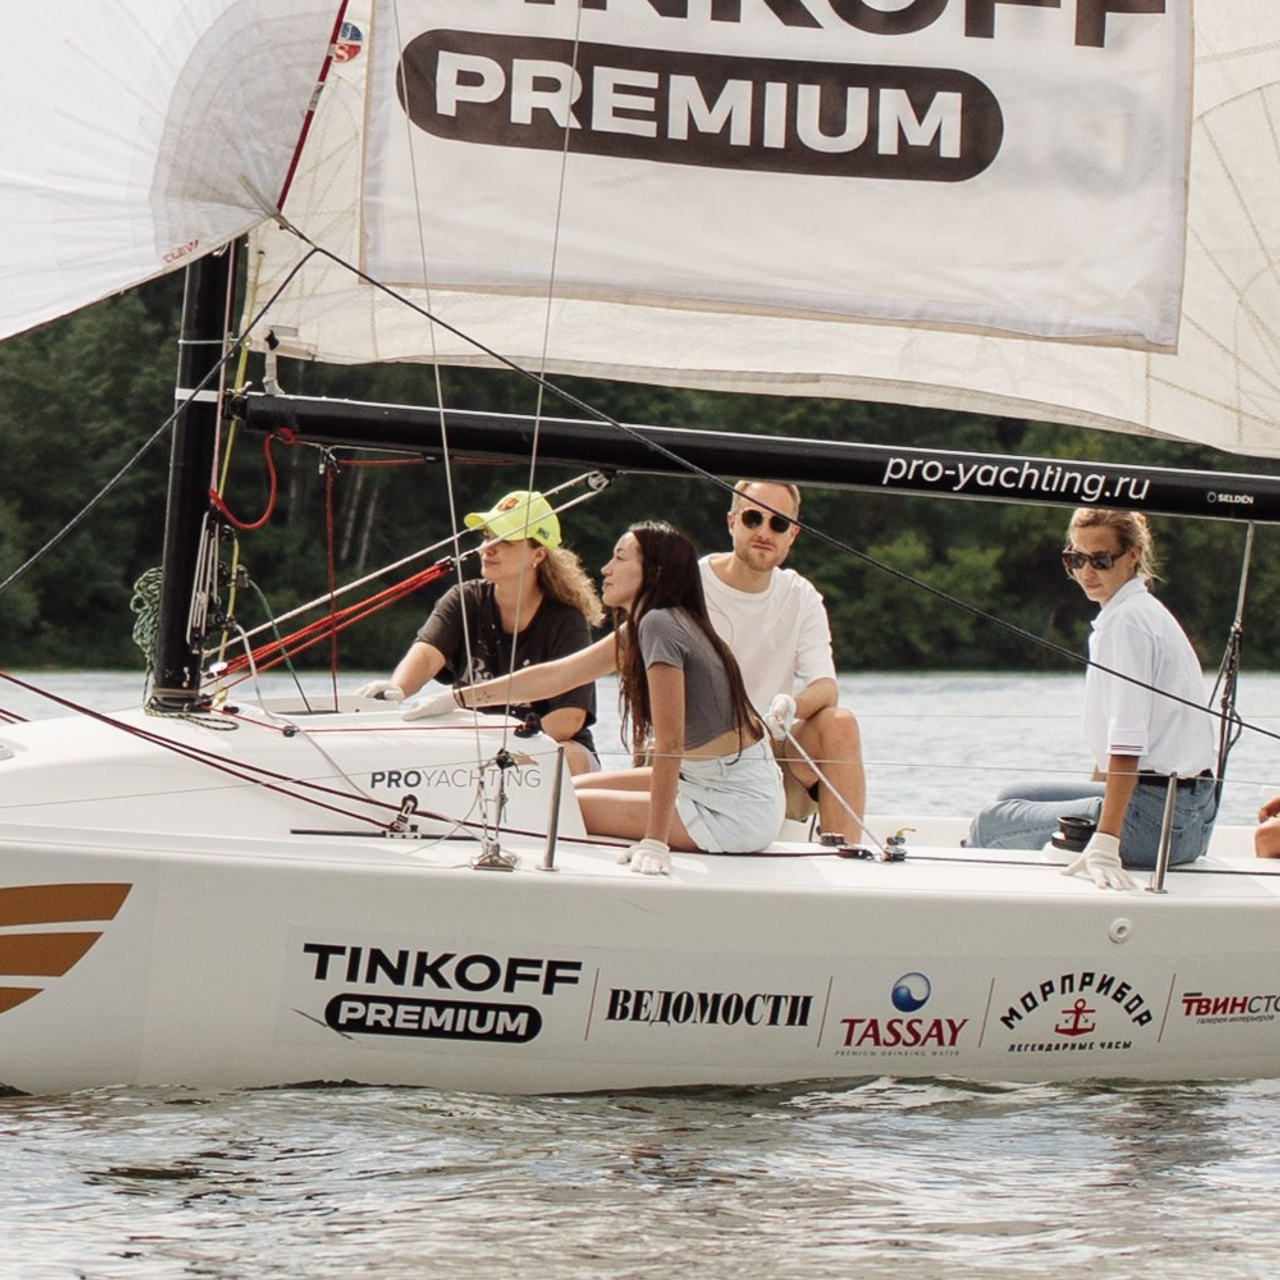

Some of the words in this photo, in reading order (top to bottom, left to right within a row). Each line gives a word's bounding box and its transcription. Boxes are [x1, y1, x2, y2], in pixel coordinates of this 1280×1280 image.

[435, 51, 963, 158] PREMIUM
[882, 457, 1150, 502] pro-yachting.ru
[371, 769, 542, 789] PROYACHTNG
[303, 943, 583, 995] TINKOFF
[338, 1001, 529, 1036] PREMIUM
[605, 988, 814, 1027] ВЕДОМОСТИ
[1000, 972, 1153, 1030] МОРПРИБОР
[840, 1018, 969, 1047] TASSAY
[1099, 1040, 1132, 1050] ЧАСЫ
